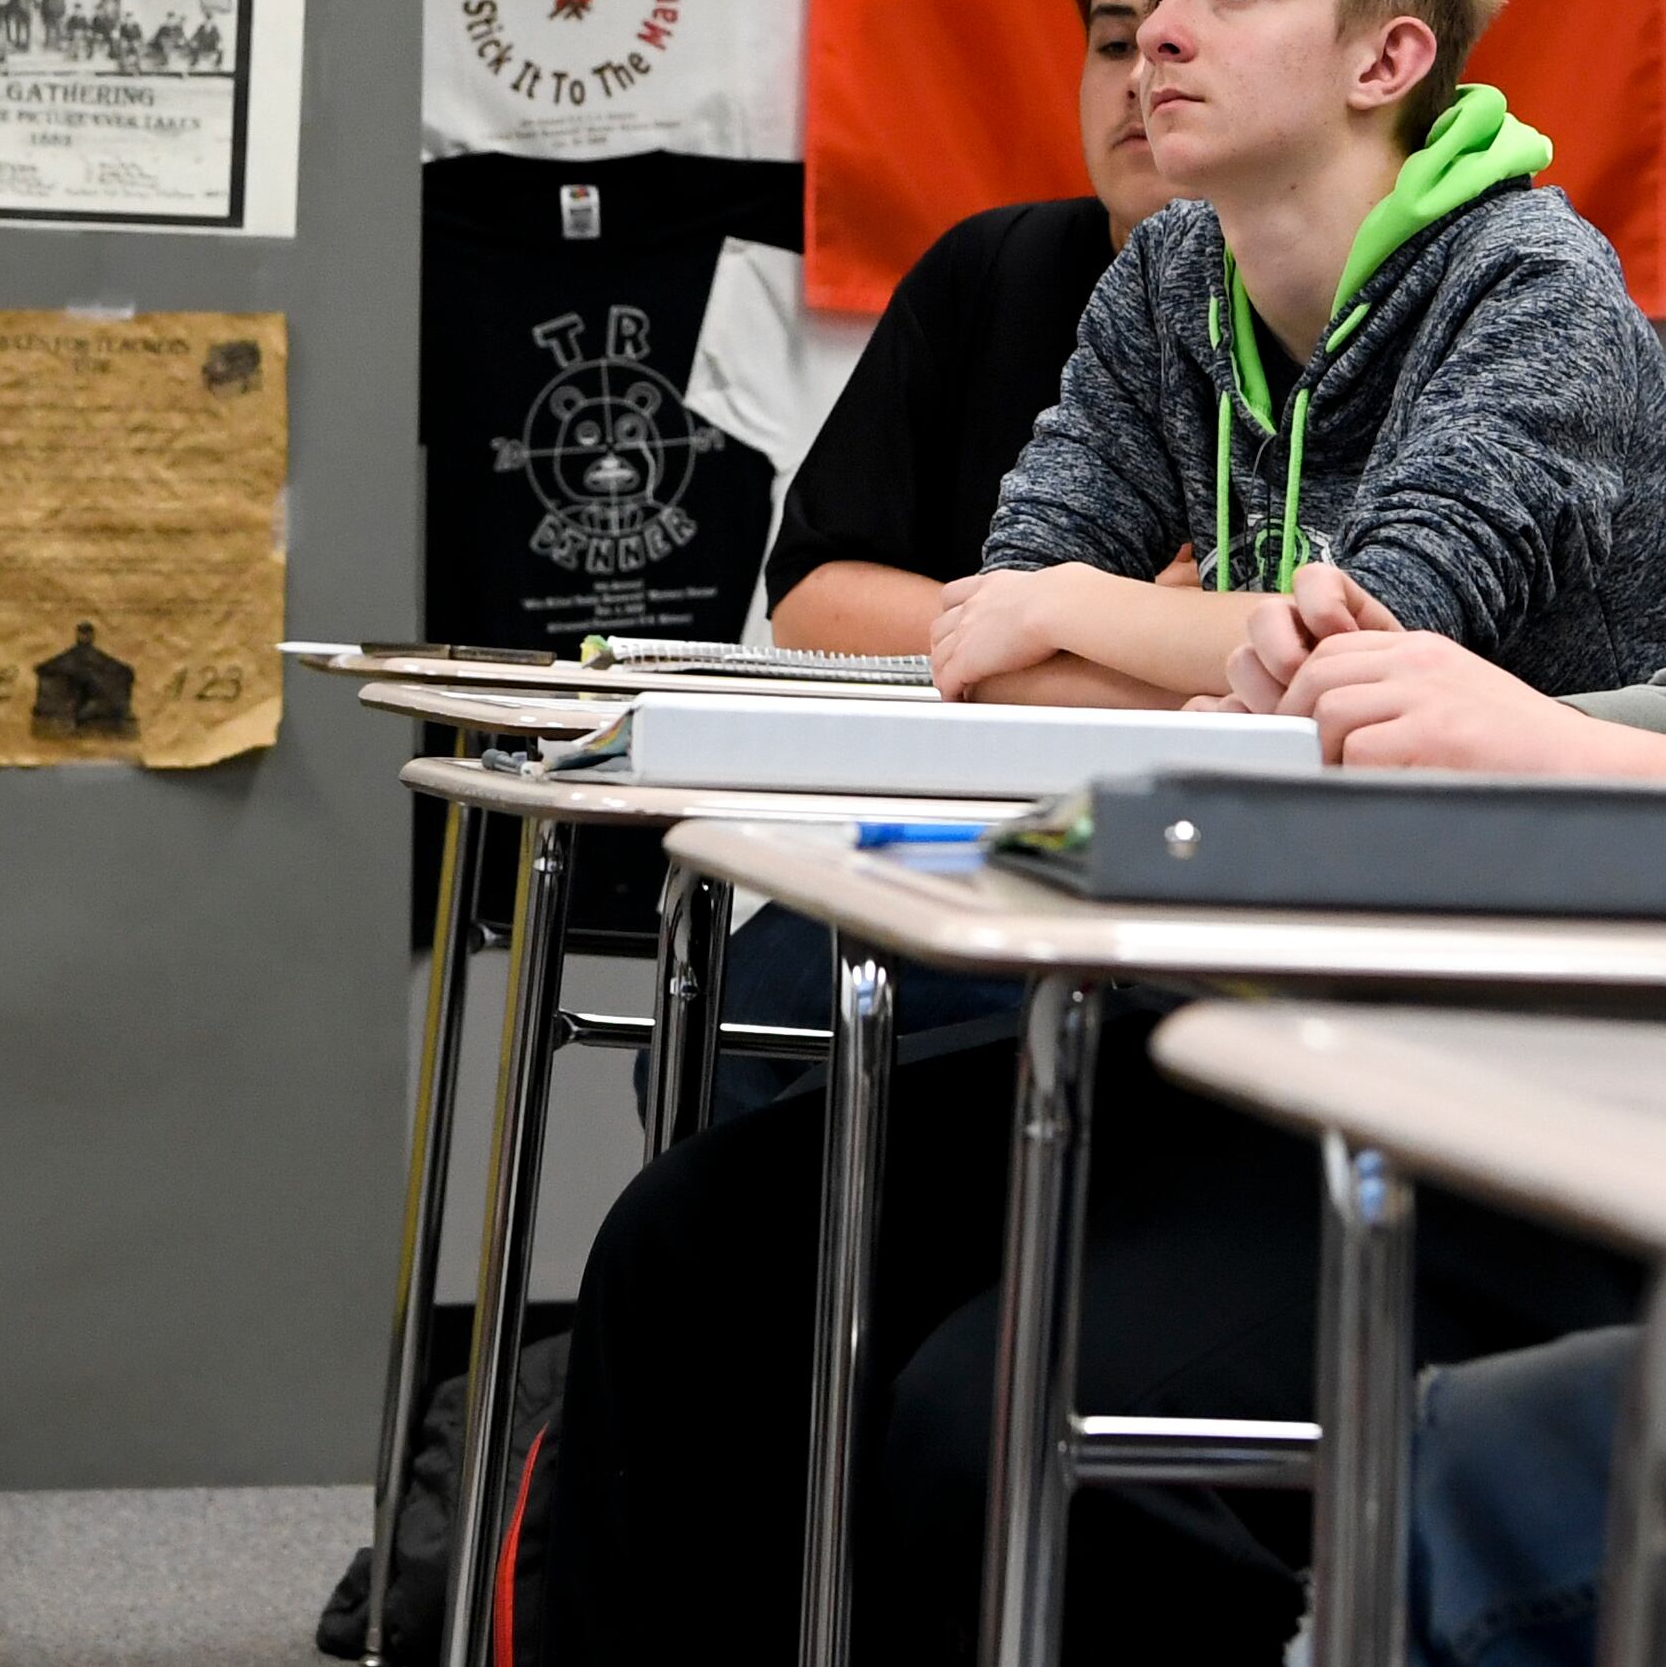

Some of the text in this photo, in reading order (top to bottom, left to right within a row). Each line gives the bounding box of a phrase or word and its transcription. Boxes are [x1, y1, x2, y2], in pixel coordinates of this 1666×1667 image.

[463, 0, 515, 76] Stick
[509, 60, 542, 100] It
[551, 70, 586, 106] To
[591, 51, 652, 99] The
[5, 83, 156, 107] GATHERING
[533, 304, 652, 369] T R
[528, 506, 699, 575] DINNER
[167, 664, 244, 703] 123
